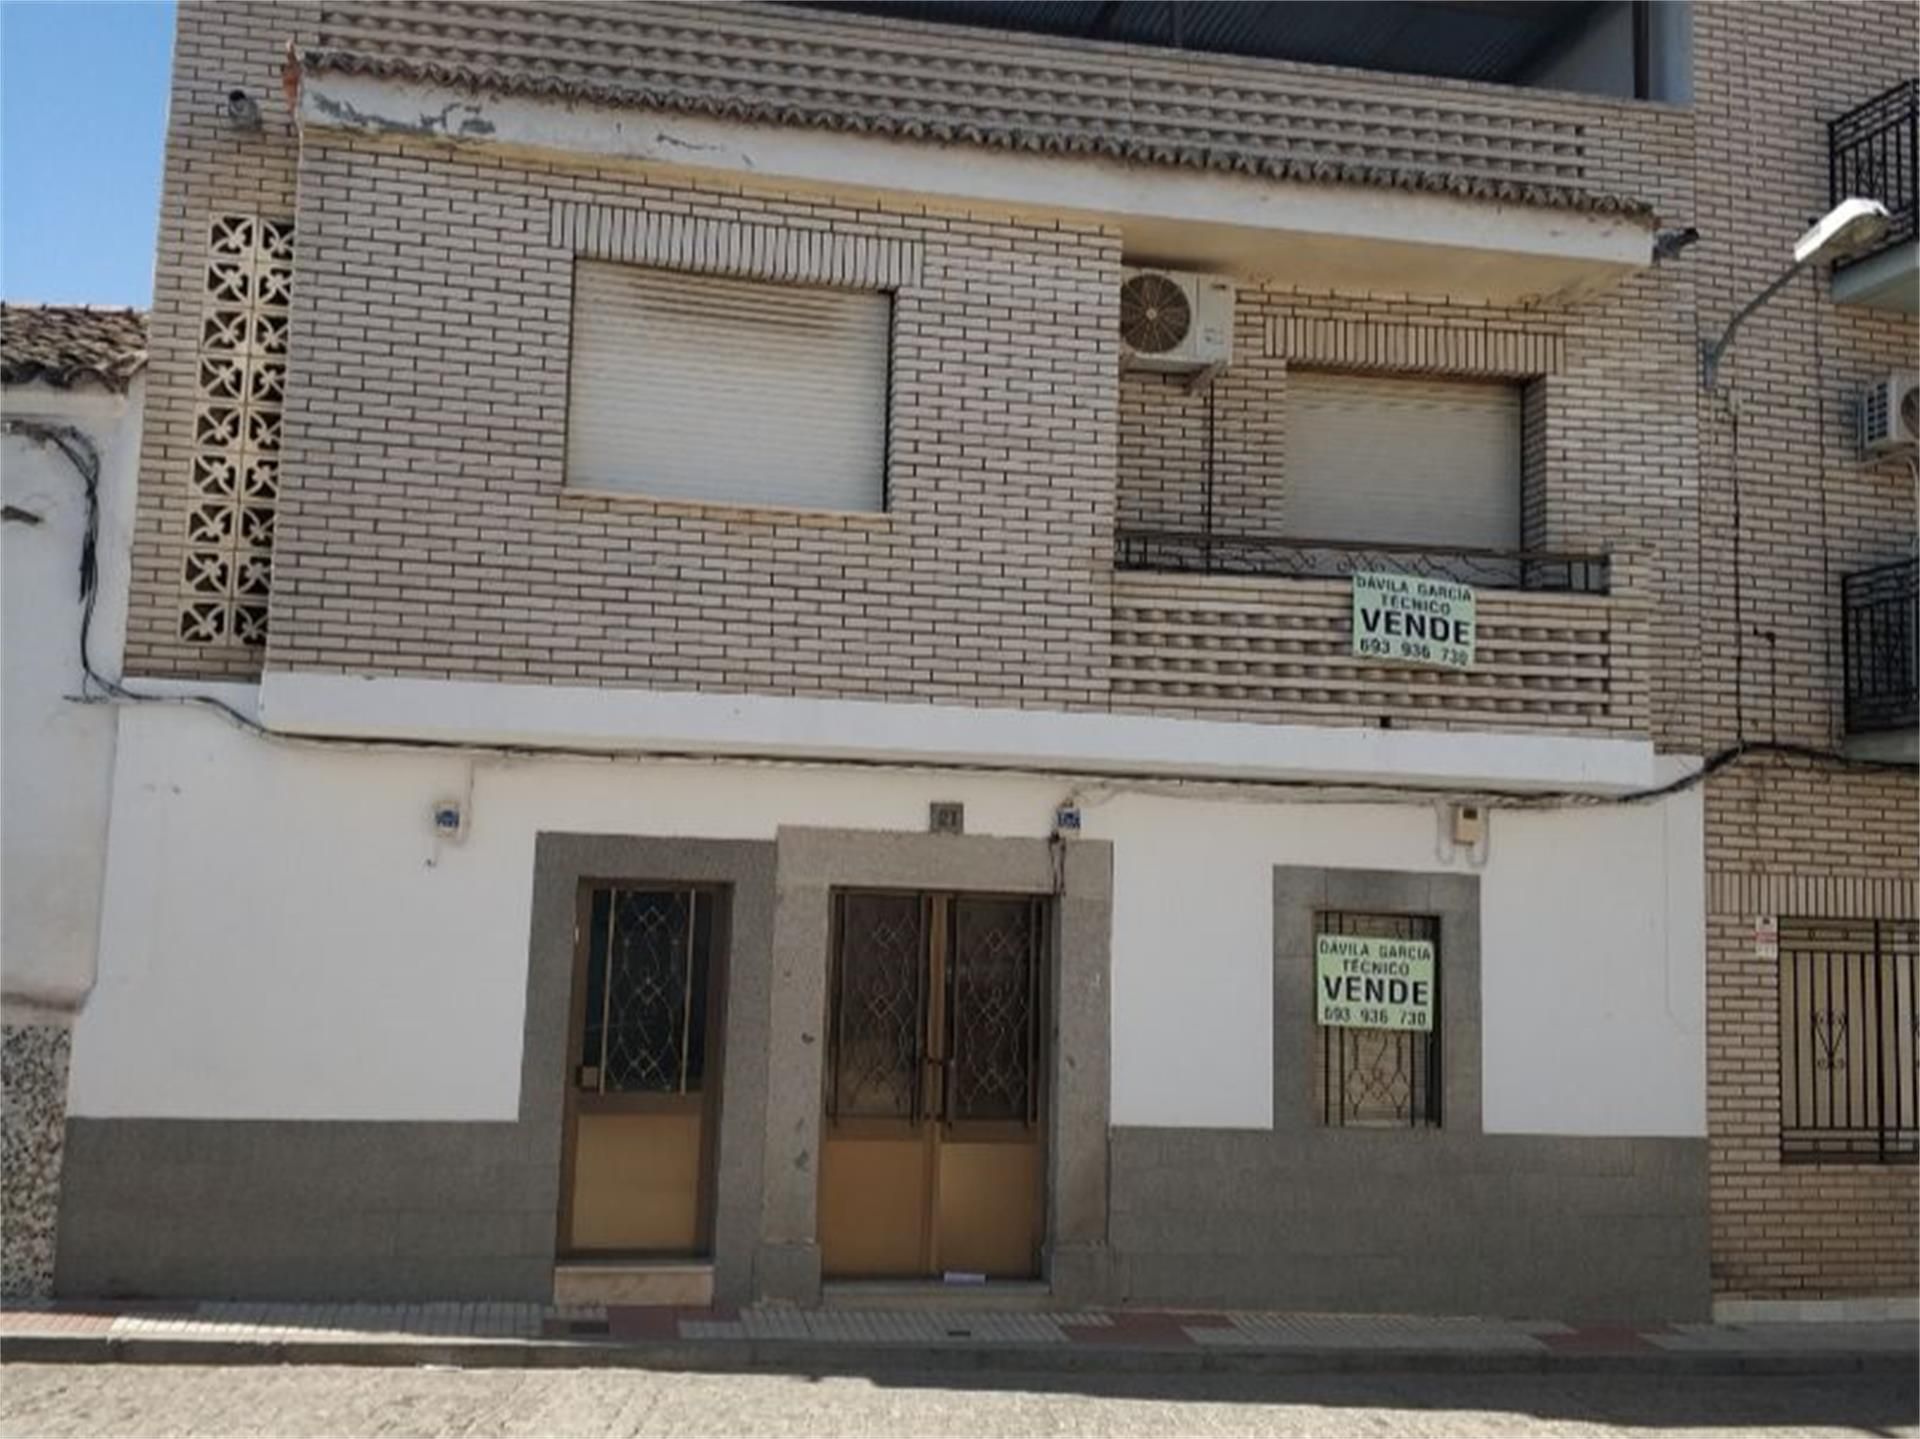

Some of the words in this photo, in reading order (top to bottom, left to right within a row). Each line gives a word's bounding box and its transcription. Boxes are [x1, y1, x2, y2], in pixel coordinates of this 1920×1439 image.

[1360, 608, 1471, 646] VENDE
[1360, 637, 1390, 654] 693
[1323, 975, 1428, 1006] VENDE
[1324, 1006, 1350, 1022] 693
[1360, 1007, 1389, 1024] 936
[1400, 1010, 1426, 1026] 730
